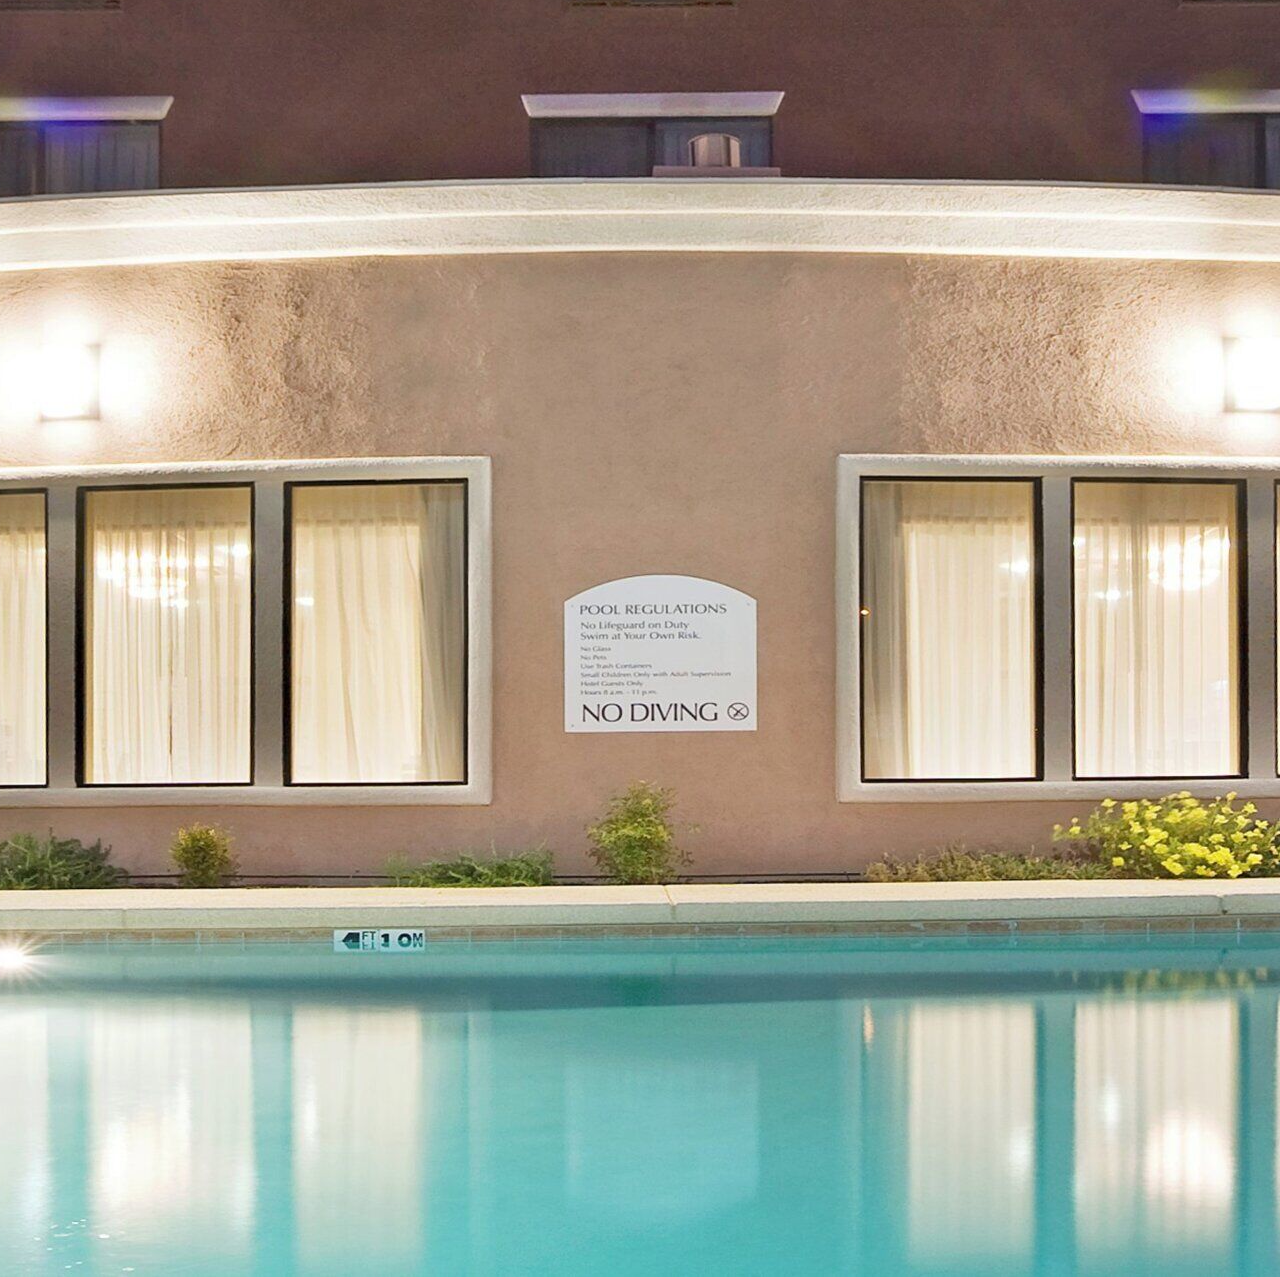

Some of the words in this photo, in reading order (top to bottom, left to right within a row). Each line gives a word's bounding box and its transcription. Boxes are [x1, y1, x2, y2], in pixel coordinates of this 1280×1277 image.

[580, 604, 621, 615] POOL
[625, 603, 728, 615] REGULATIONS
[599, 621, 646, 631] Lifeguard
[664, 621, 690, 630] Duty
[580, 632, 609, 640] Swim
[624, 632, 646, 640] Your
[649, 631, 675, 640] Own
[582, 703, 623, 723] NO
[630, 702, 719, 722] DIVING
